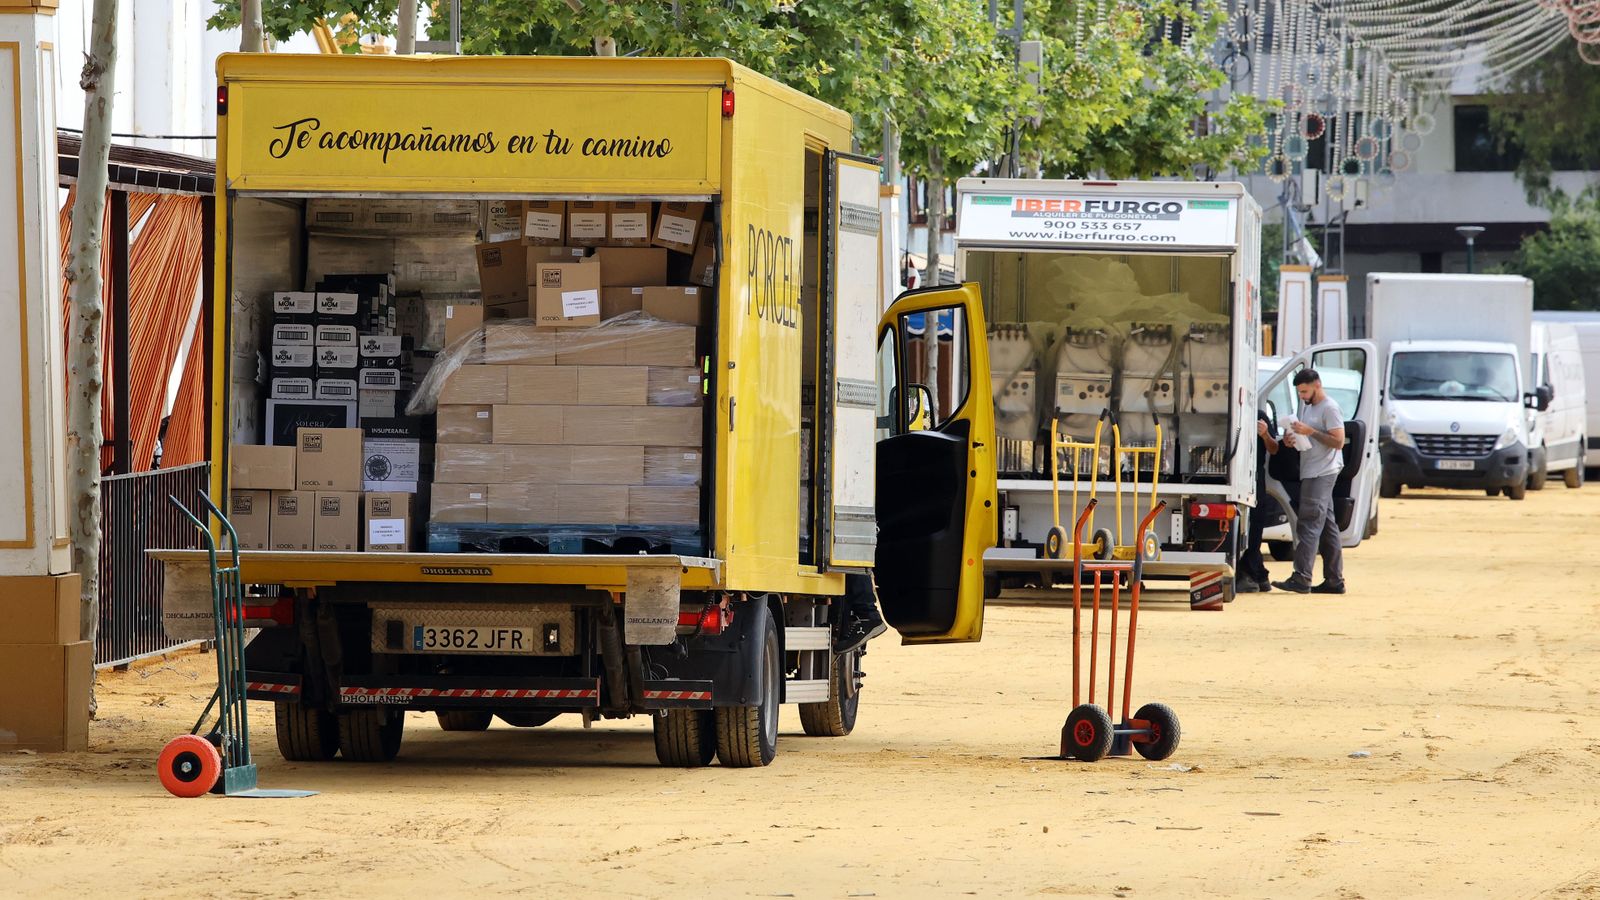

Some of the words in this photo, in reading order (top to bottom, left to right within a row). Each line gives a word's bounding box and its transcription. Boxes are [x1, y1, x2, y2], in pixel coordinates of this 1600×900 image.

[269, 117, 320, 159] Te
[318, 126, 500, 165] acompañamos
[506, 135, 539, 154] en
[542, 129, 575, 155] tu
[582, 136, 674, 158] camino
[1032, 211, 1078, 219] ALQUILER
[1096, 212, 1158, 221] FURGONETAS
[1043, 220, 1077, 230] 900
[1081, 221, 1109, 231] 533
[1112, 222, 1143, 231] 657
[1008, 230, 1177, 242] www.iberfurgo.com
[371, 427, 409, 435] INSUPERABLE
[422, 566, 492, 576] DHOLLANDIA
[415, 640, 421, 648] E
[425, 628, 479, 649] 3362
[484, 629, 523, 650] JFR
[342, 694, 412, 704] DHOLLANDIA
